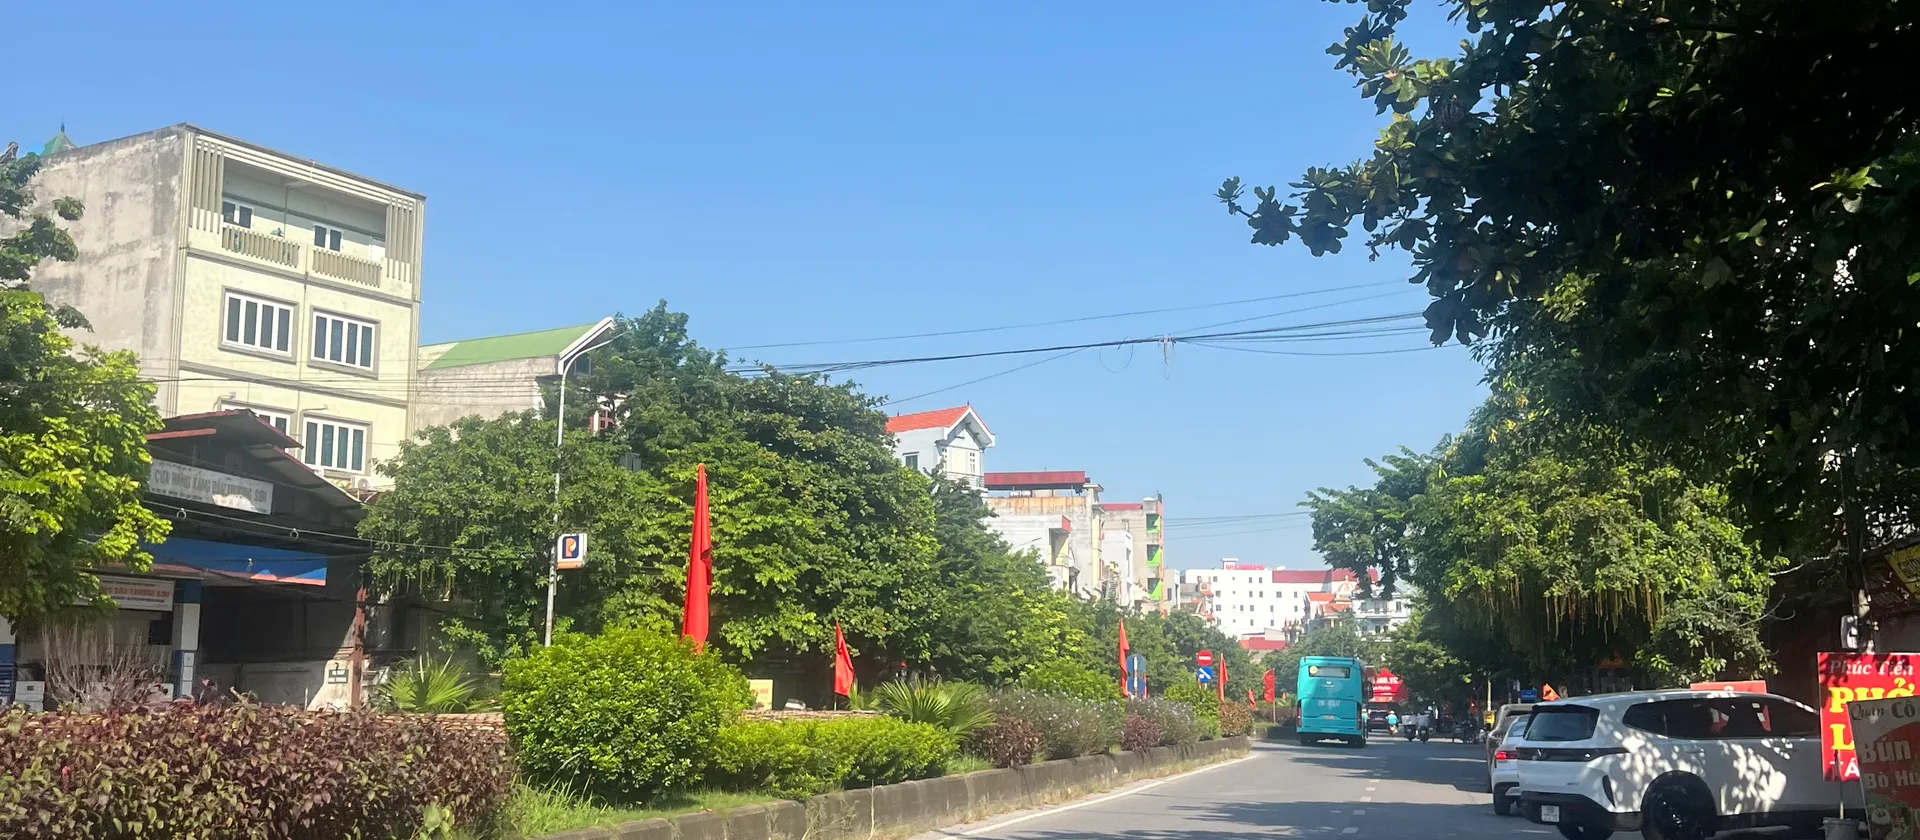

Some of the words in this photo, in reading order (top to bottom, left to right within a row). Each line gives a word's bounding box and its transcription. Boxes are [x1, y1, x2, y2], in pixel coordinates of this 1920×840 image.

[1830, 659, 1872, 675] Phúc
[1878, 658, 1914, 676] Tiến
[1861, 735, 1912, 764] Bún
[1863, 770, 1889, 789] Bò
